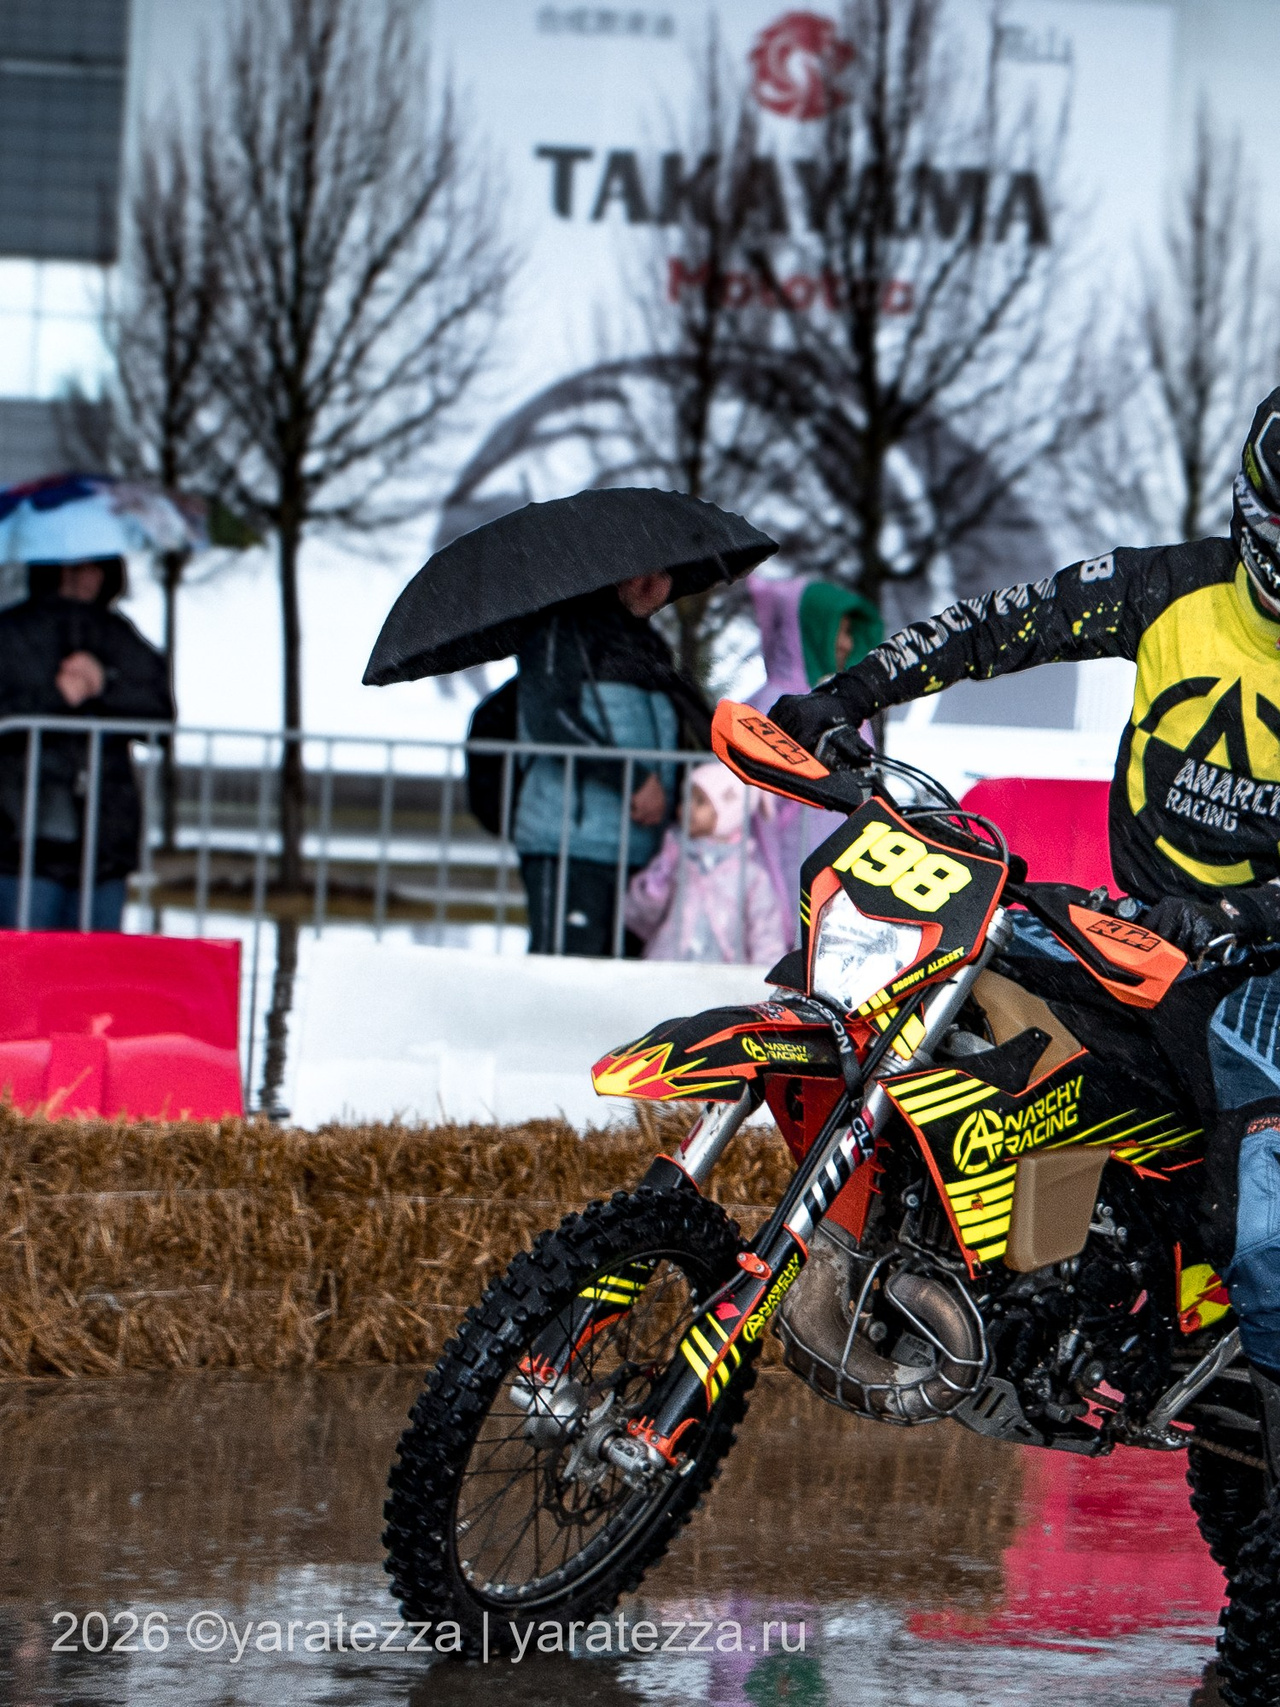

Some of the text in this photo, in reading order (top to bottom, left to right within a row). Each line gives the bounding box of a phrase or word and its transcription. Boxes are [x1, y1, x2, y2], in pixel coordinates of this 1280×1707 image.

[738, 717, 807, 765] KTM
[1164, 787, 1240, 832] RACING
[832, 820, 973, 913] 198
[1086, 919, 1162, 952] KTM
[1004, 1102, 1079, 1154] RACING
